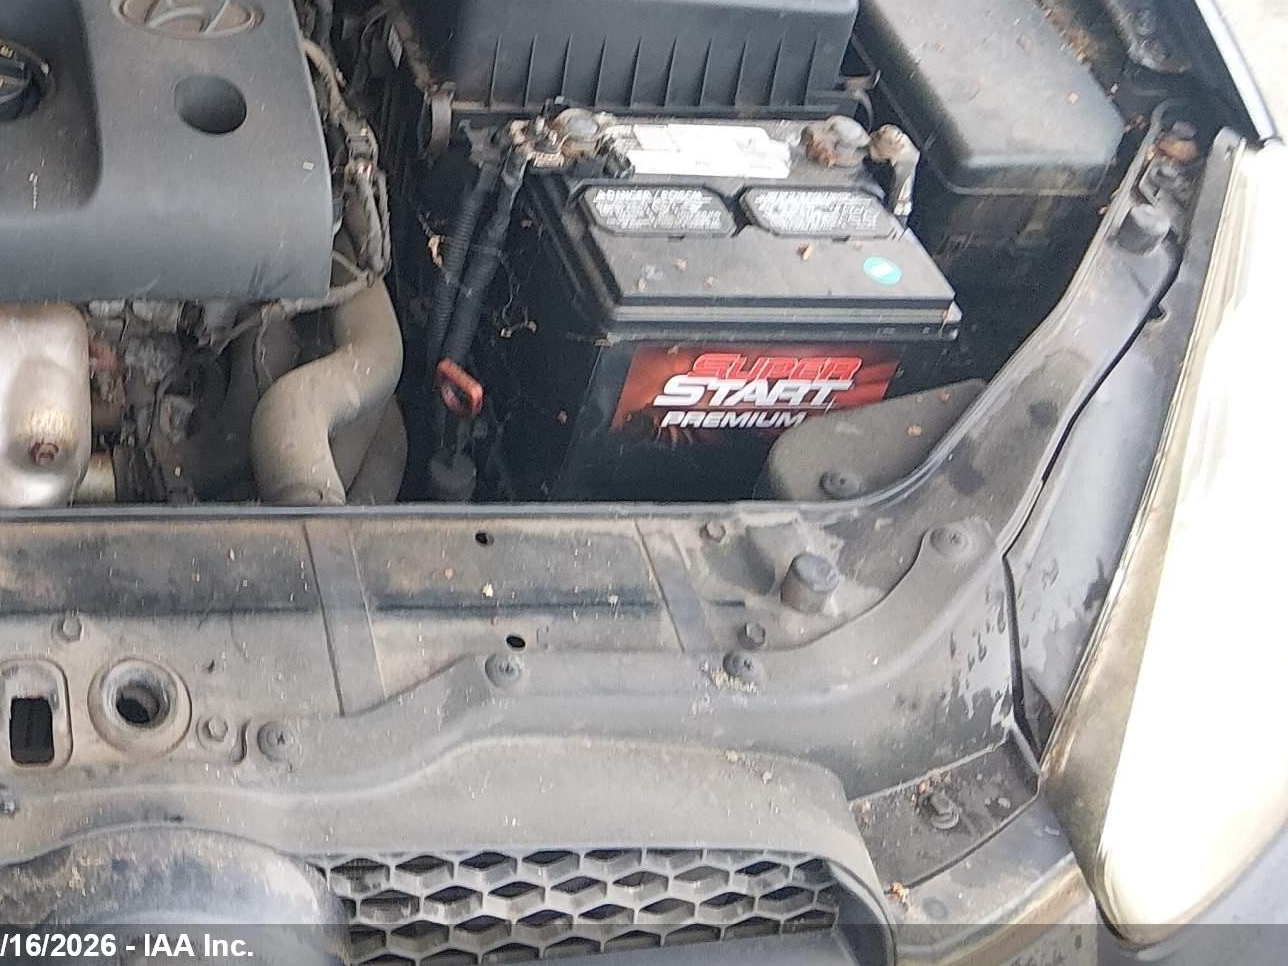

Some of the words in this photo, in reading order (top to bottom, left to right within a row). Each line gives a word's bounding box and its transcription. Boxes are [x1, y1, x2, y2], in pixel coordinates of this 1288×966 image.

[687, 353, 862, 381] SUPER
[653, 374, 855, 407] START
[661, 410, 808, 429] PREMIUM
